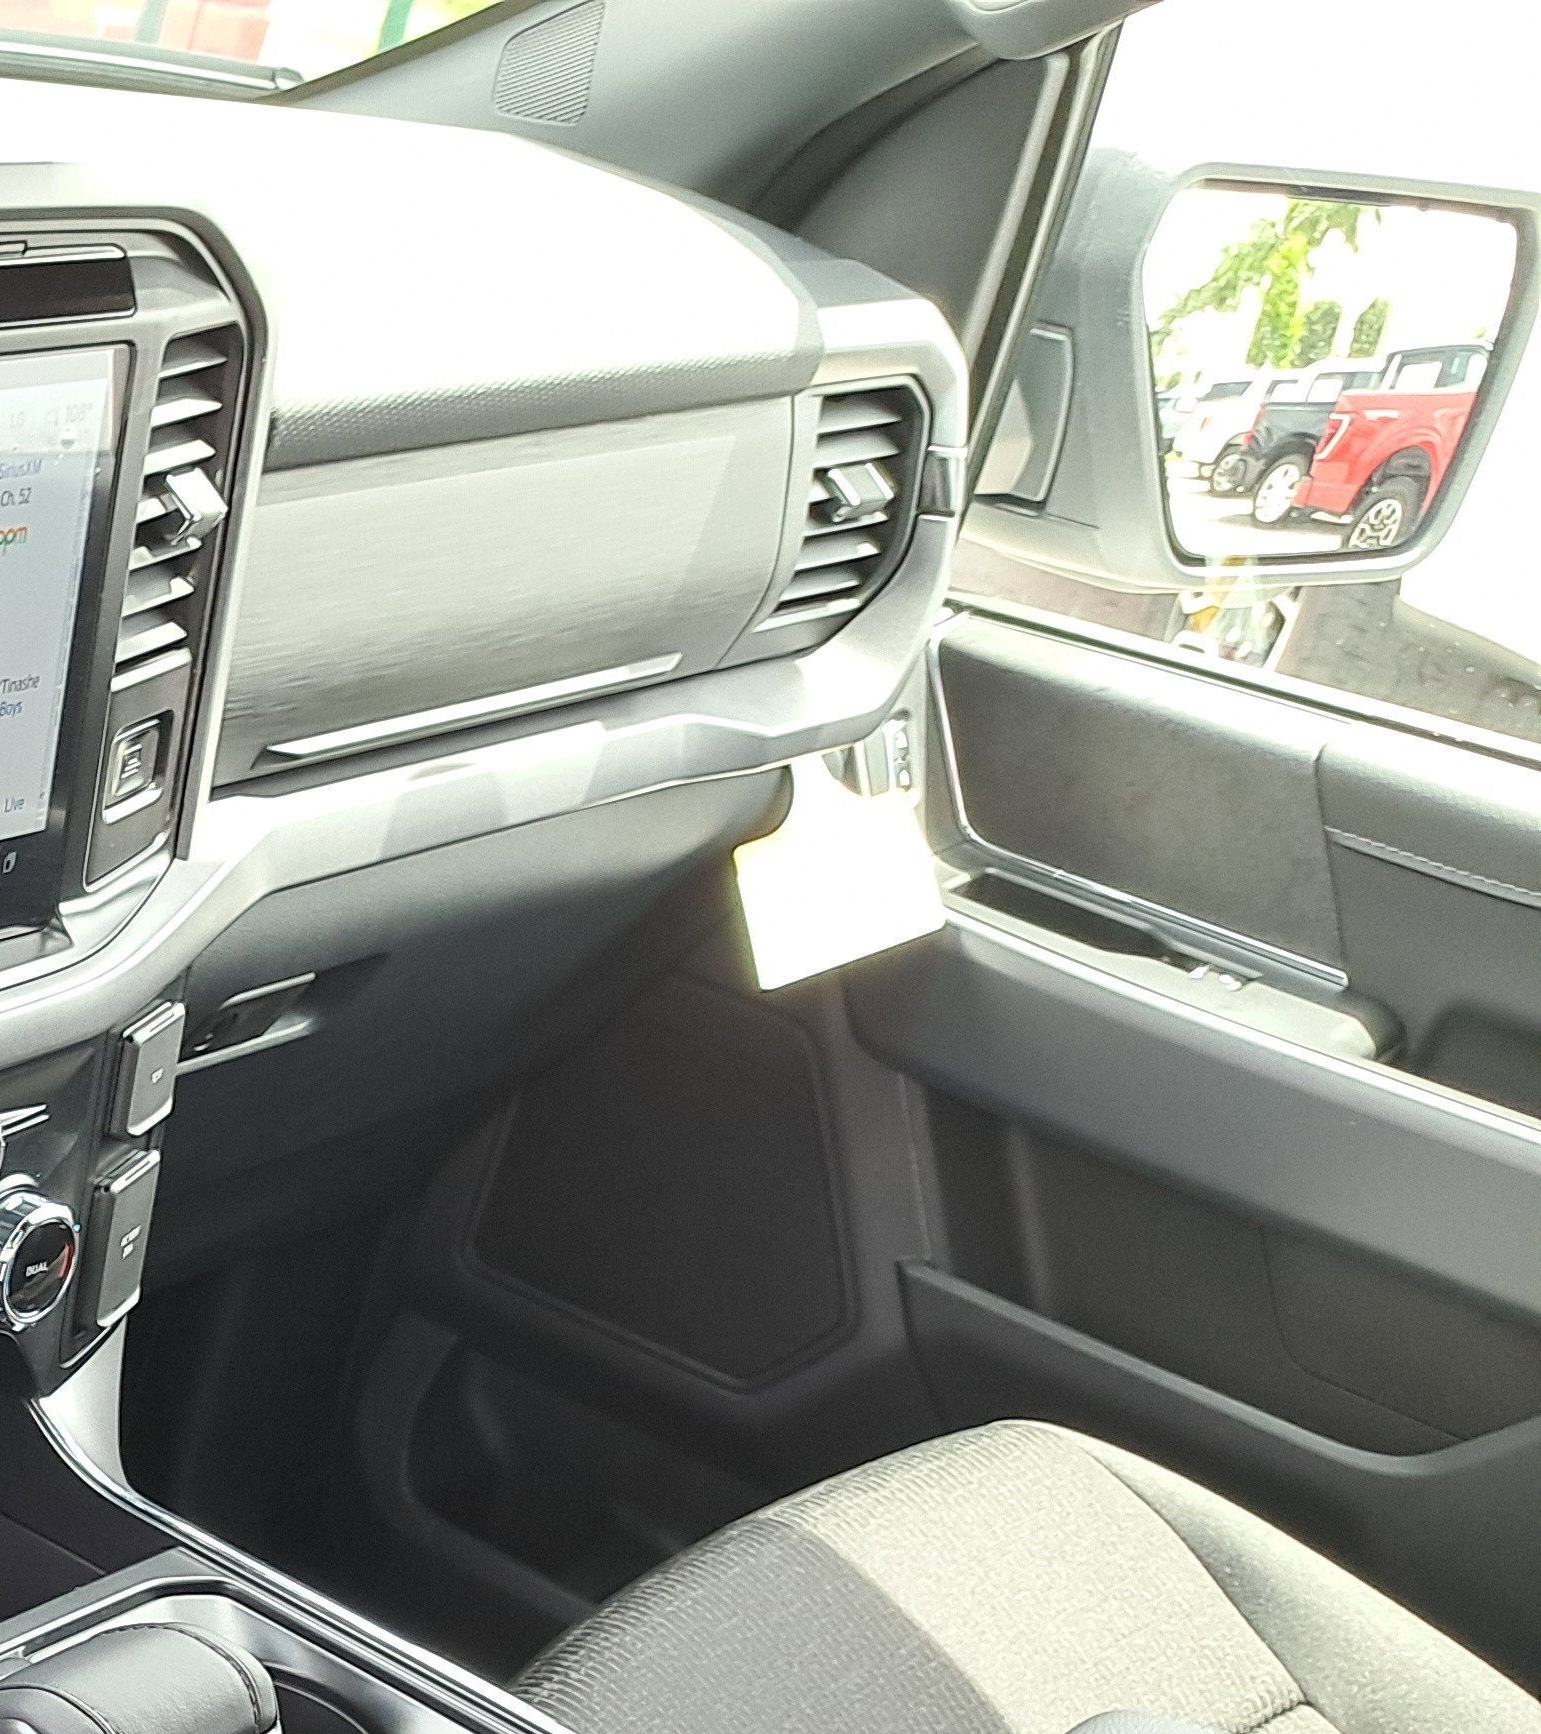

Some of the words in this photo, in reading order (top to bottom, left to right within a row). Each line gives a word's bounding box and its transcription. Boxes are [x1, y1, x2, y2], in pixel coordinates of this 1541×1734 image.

[18, 487, 32, 505] 52
[0, 701, 23, 718] Boys
[4, 797, 26, 813] Live
[26, 1262, 49, 1278] DUAL
